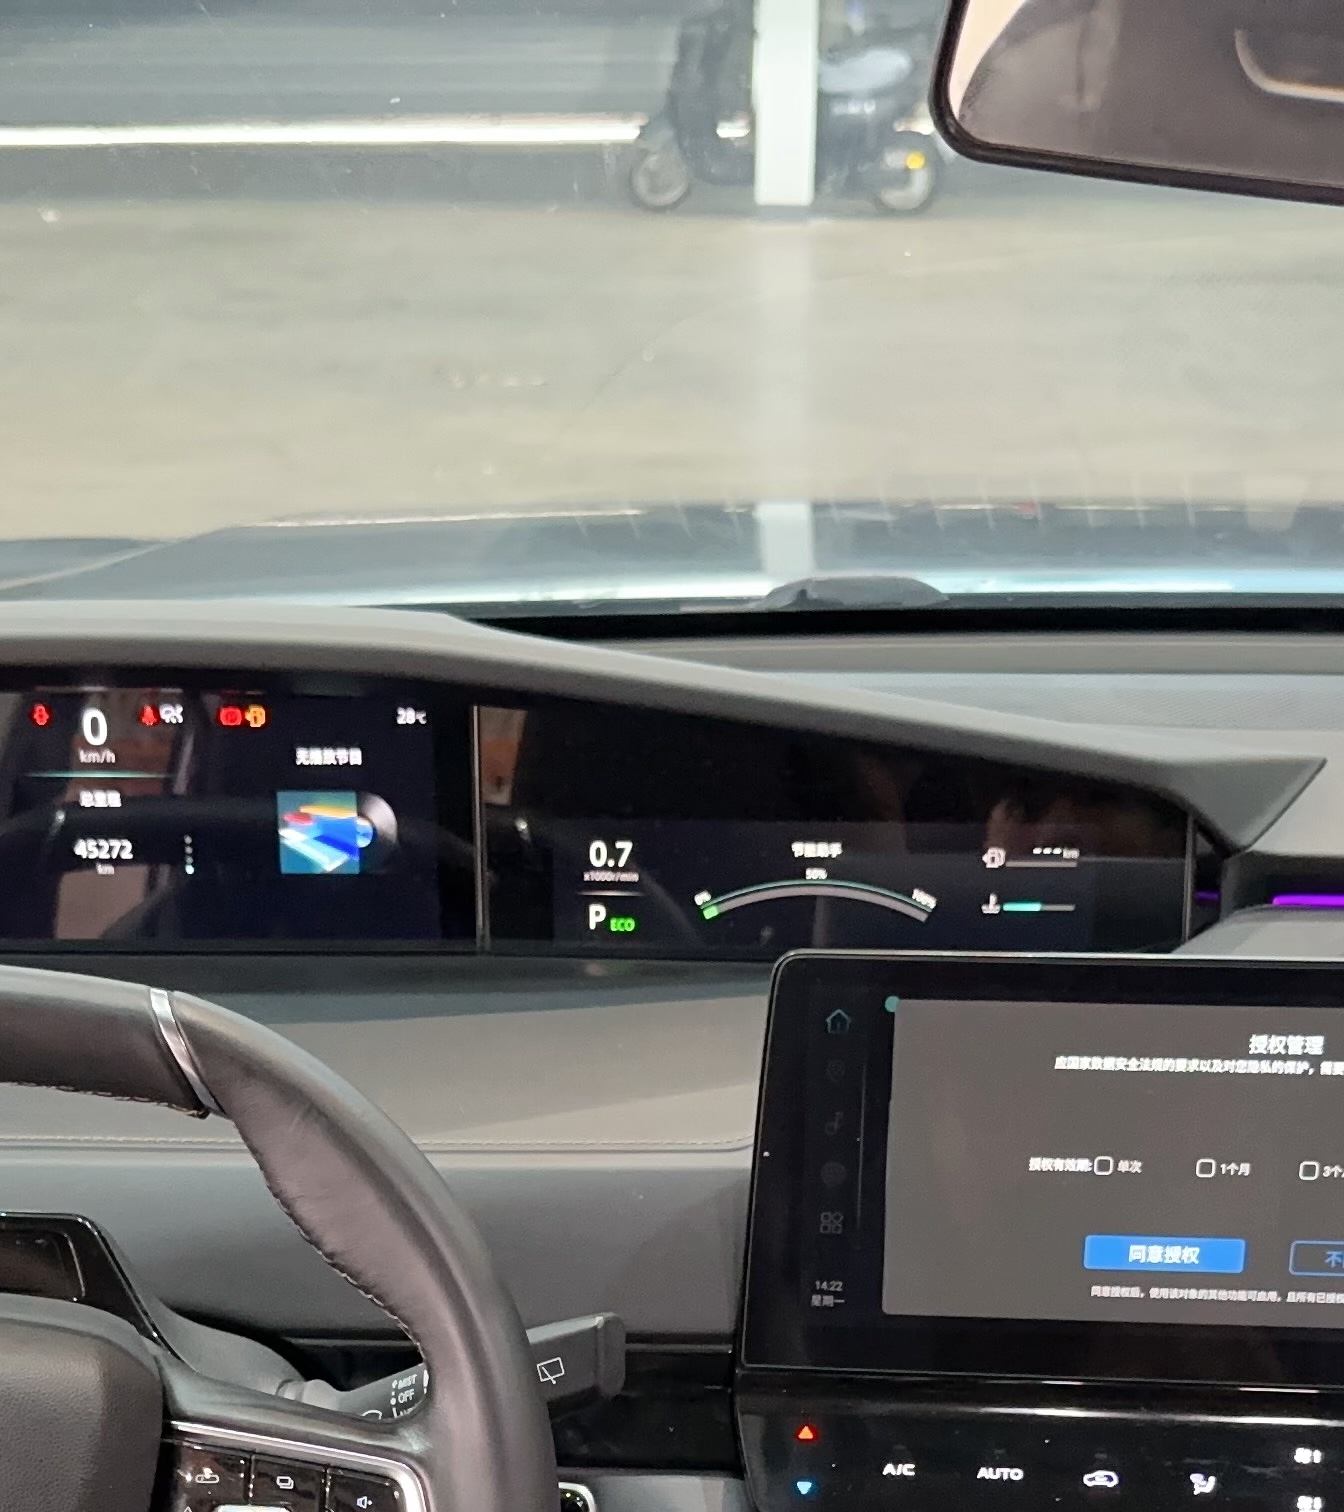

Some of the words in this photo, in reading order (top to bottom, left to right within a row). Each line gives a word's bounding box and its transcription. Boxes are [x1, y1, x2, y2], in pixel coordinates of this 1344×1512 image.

[81, 708, 108, 747] 0
[79, 750, 116, 764] km/h
[73, 838, 133, 860] 45272
[589, 840, 633, 868] 0.7
[589, 903, 607, 930] P
[610, 917, 636, 932] ECO
[1249, 1034, 1325, 1055] 授权管理
[1219, 1162, 1251, 1177] 1个月
[1128, 1244, 1201, 1265] 同意授权
[398, 1389, 415, 1403] OFF
[882, 1462, 916, 1477] A/C
[977, 1466, 1024, 1482] AUTO
